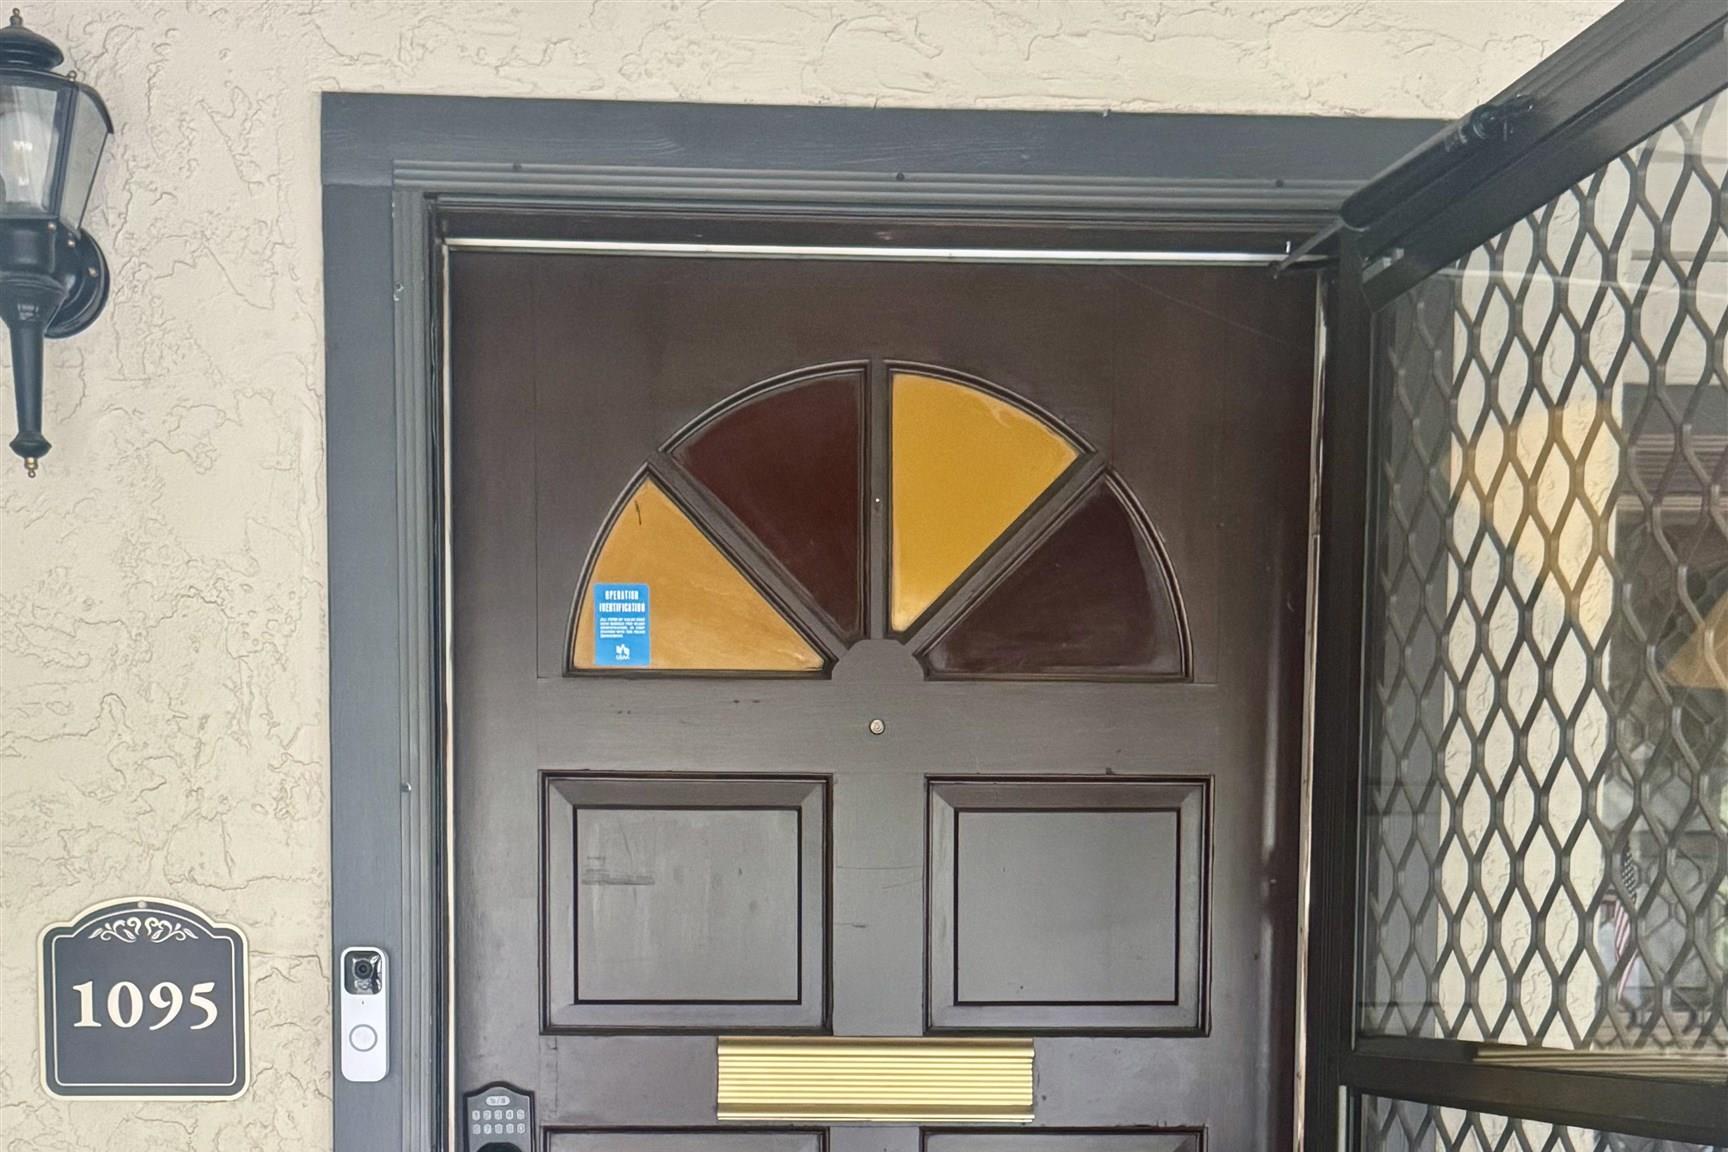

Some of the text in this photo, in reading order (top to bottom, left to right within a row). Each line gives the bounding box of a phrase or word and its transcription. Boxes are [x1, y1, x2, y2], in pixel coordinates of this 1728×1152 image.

[605, 590, 639, 600] OPERATION
[599, 602, 645, 613] IDENTIFICATION
[72, 980, 218, 1031] 1095
